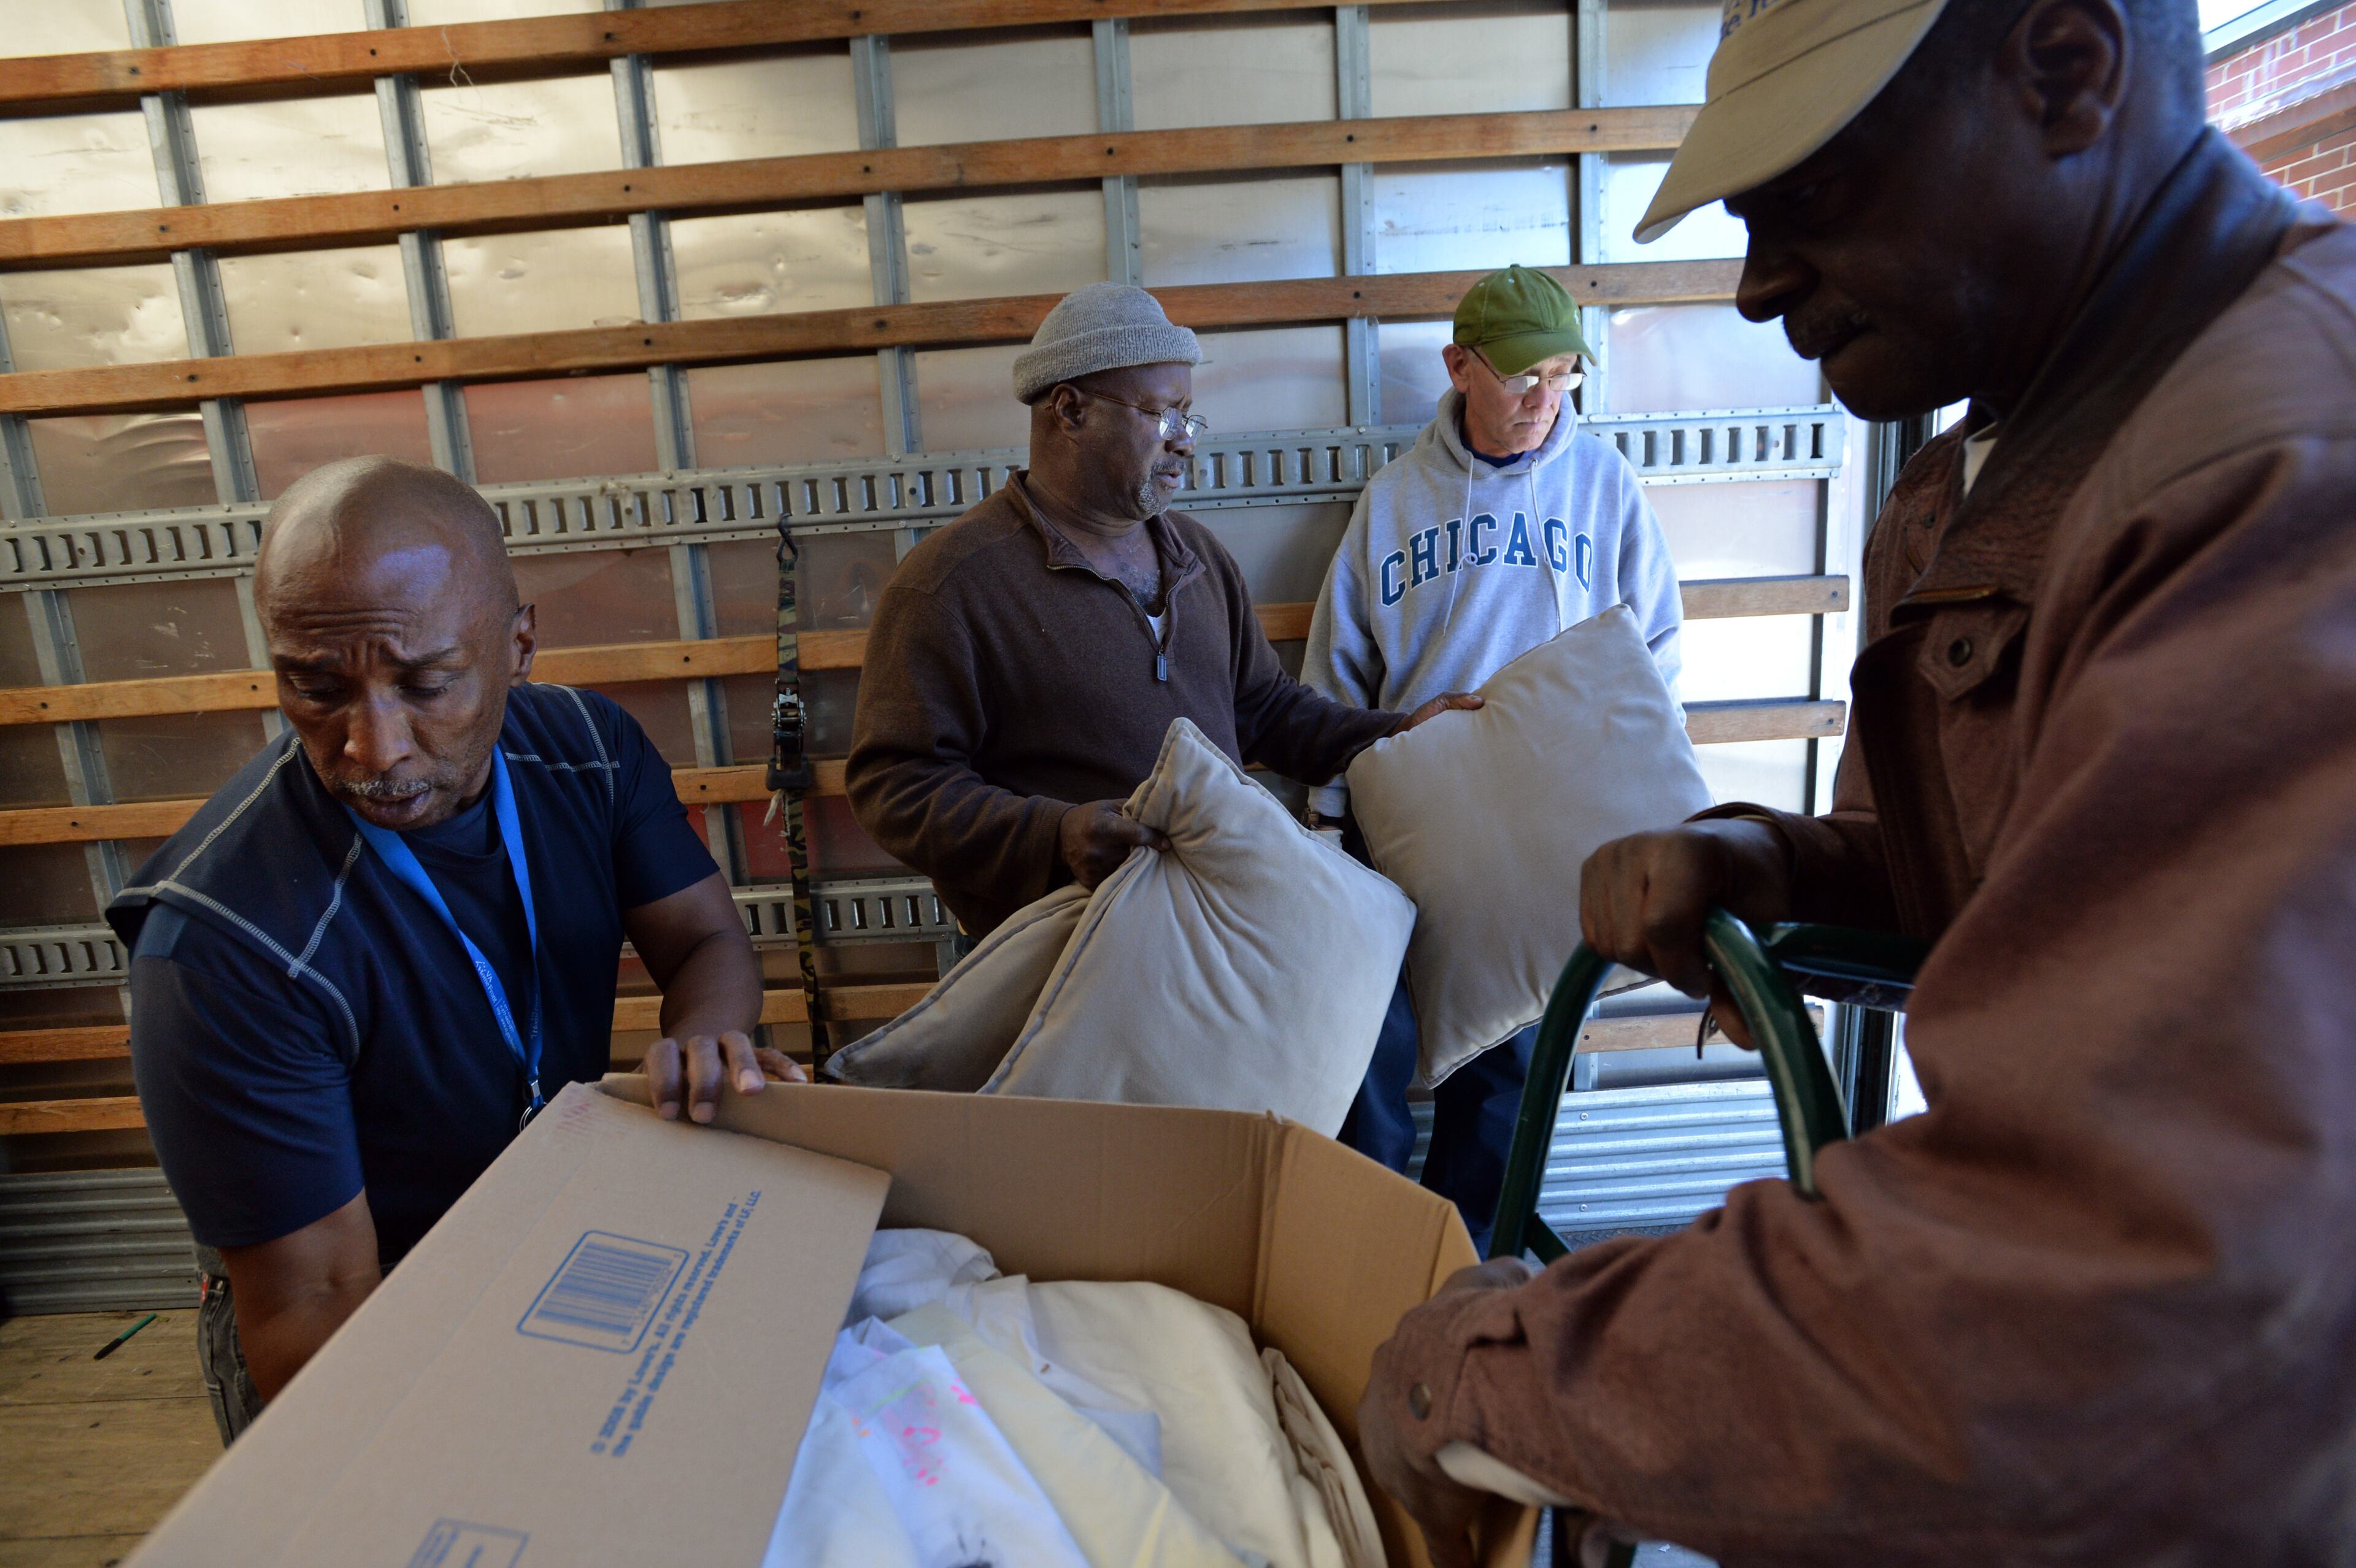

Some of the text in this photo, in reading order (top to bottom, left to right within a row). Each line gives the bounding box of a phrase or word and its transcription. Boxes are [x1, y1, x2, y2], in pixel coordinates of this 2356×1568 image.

[1380, 510, 1593, 607] CHICAGO
[487, 971, 493, 983] VA
[664, 1293, 688, 1322] rights
[706, 1218, 729, 1248] Lowe's
[681, 1278, 714, 1330] registered
[706, 1229, 741, 1278] trademarks
